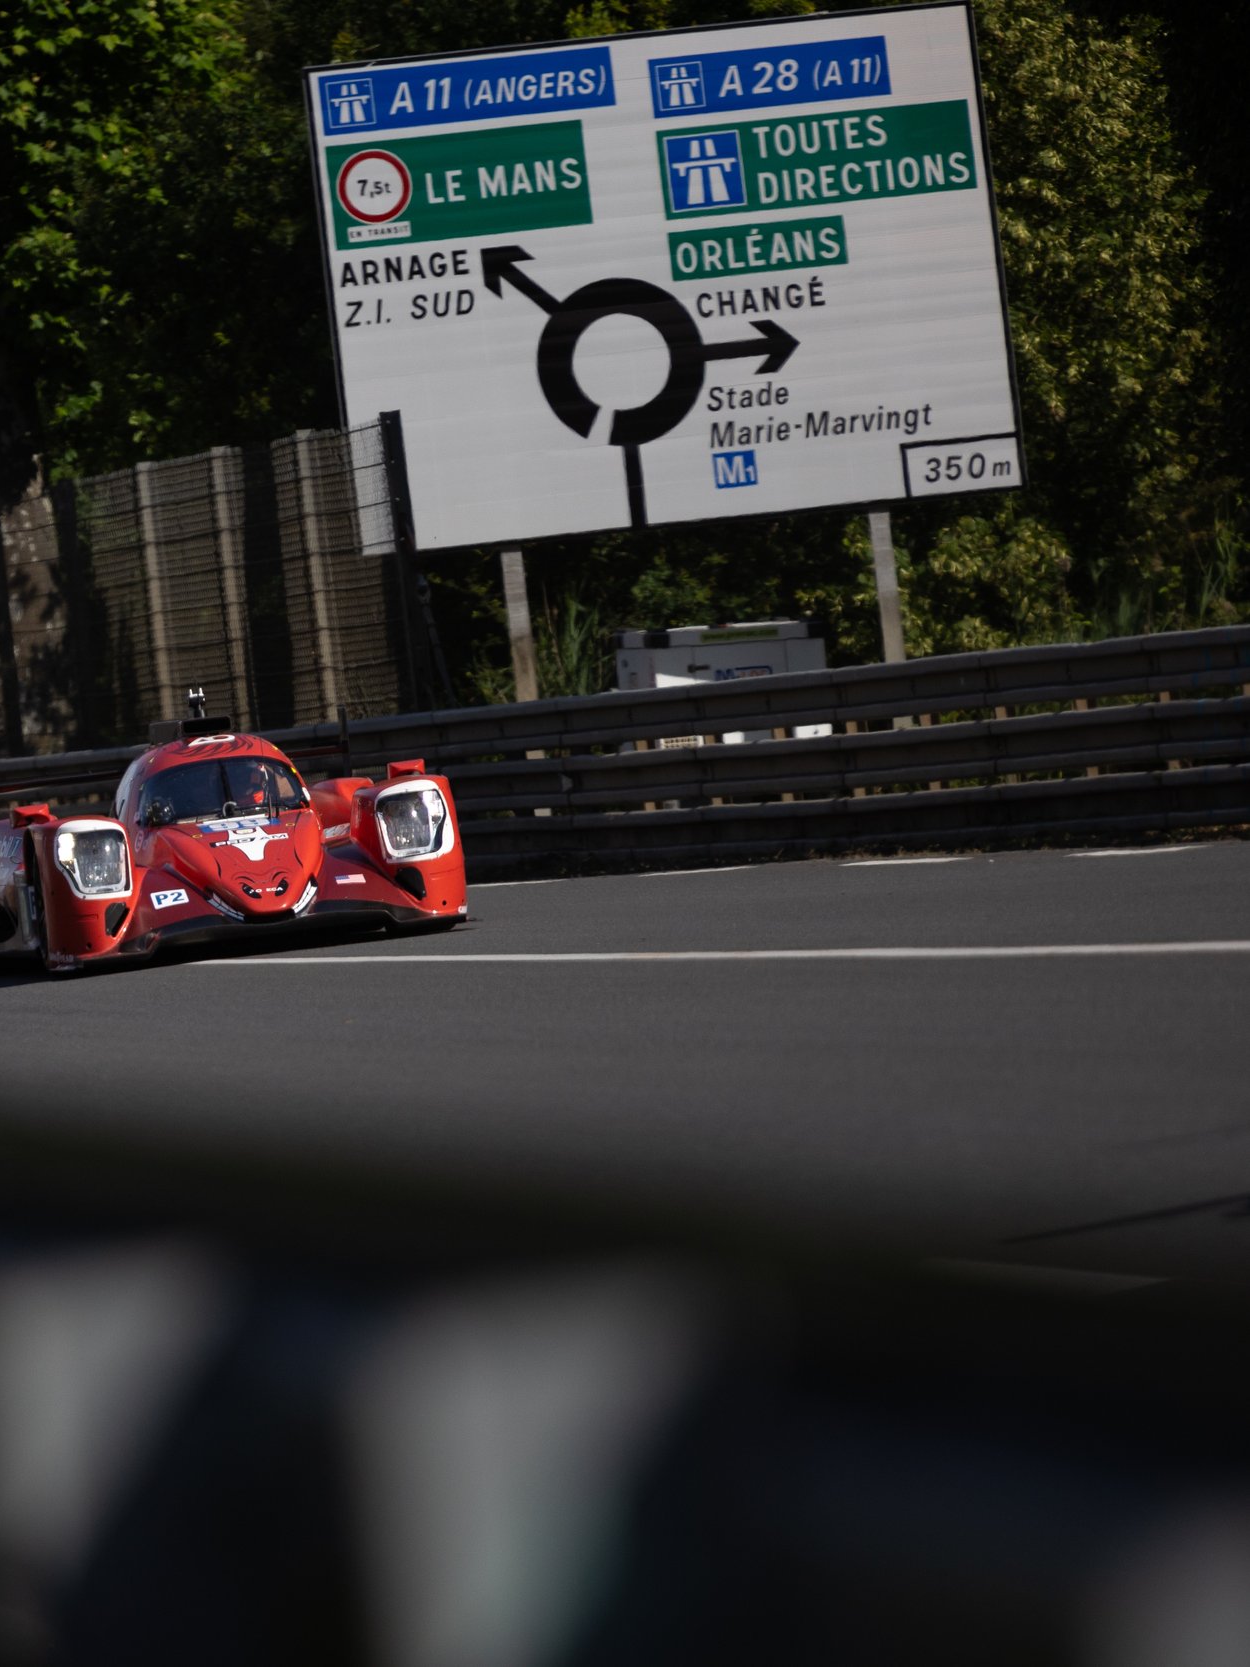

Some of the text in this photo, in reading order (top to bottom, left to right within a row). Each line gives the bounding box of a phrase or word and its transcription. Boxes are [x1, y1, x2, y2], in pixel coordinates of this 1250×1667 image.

[464, 65, 606, 110] (ANGERS)
[752, 114, 888, 159] TOUTES
[357, 179, 391, 199] 7,5t
[425, 158, 582, 204] LE MANS
[757, 151, 970, 204] DIRECTIONS
[340, 249, 470, 288] ARNAGE
[676, 228, 841, 274] ORLÉANS
[344, 289, 475, 329] Z.I. SUD
[696, 276, 826, 318] CHANGÉ
[707, 381, 790, 411] Stade
[710, 404, 932, 449] Marie-Marvingt
[925, 453, 1012, 483] 350 m
[155, 892, 185, 905] P2
